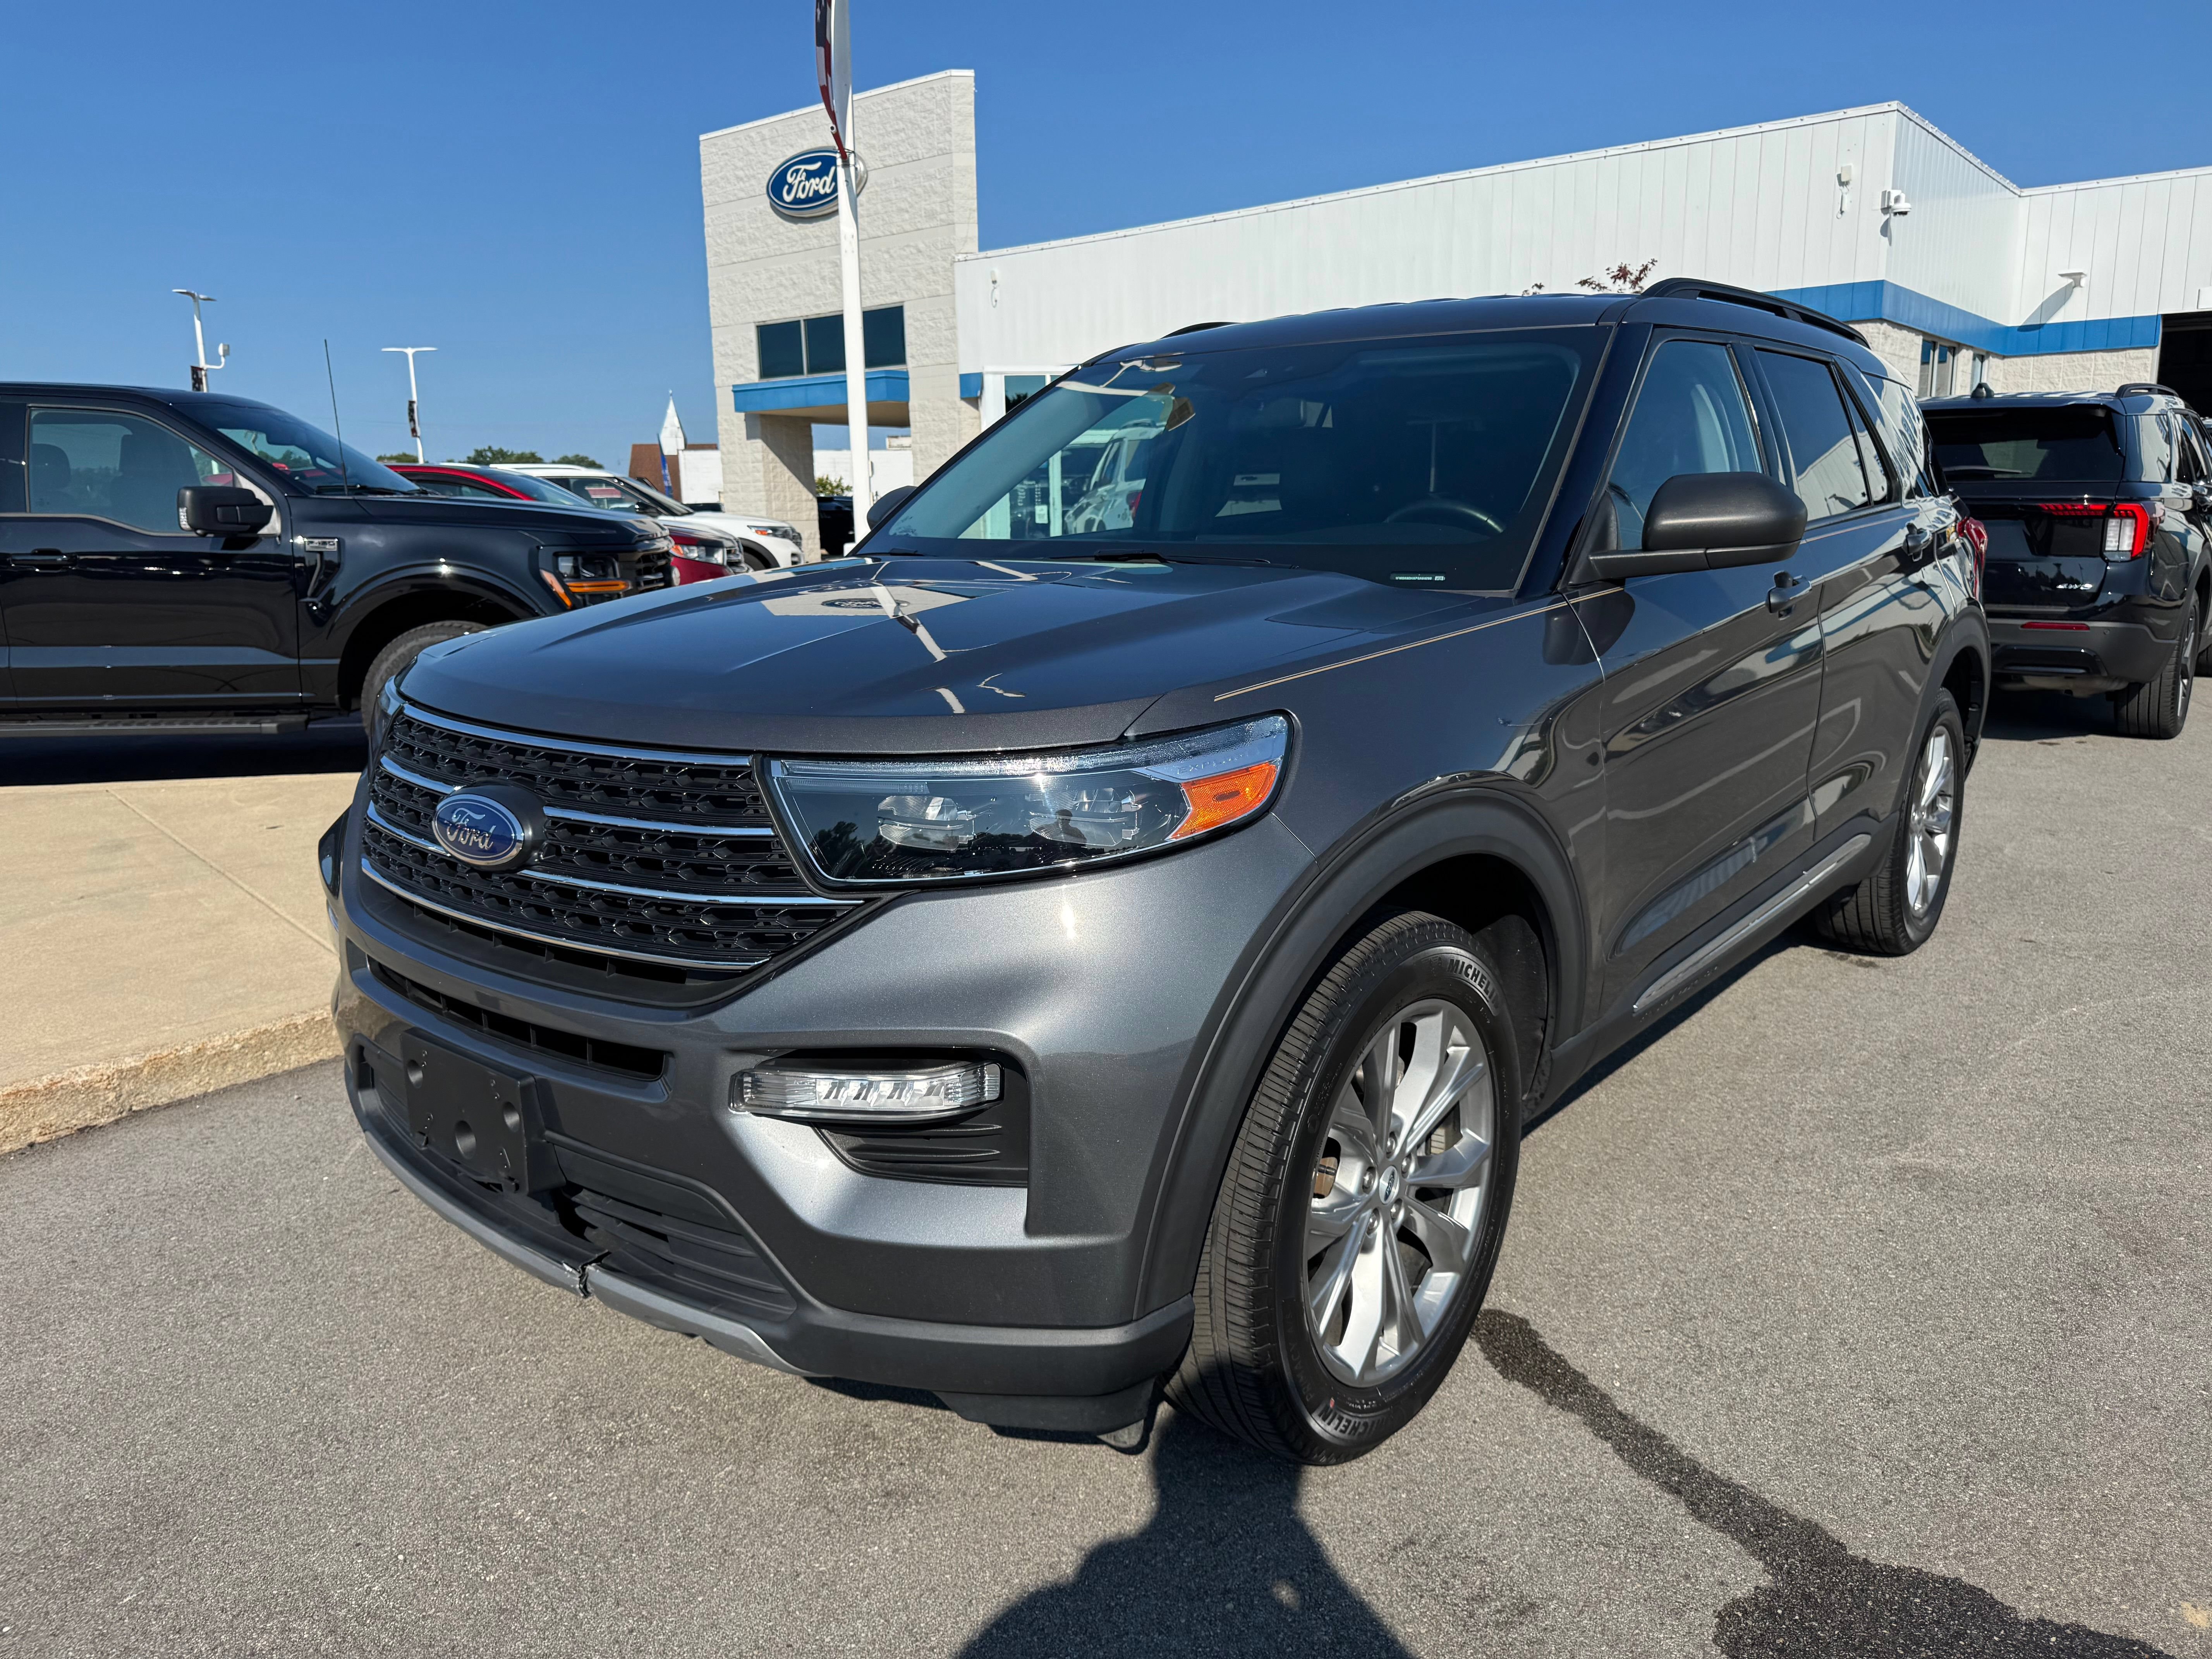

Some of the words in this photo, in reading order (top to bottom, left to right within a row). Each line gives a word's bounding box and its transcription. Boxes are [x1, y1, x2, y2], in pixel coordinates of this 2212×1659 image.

[783, 161, 836, 202] Ford
[446, 807, 496, 850] Ford
[1447, 958, 1499, 1008] MICHELIN
[1317, 1404, 1387, 1435] MICHELIN
